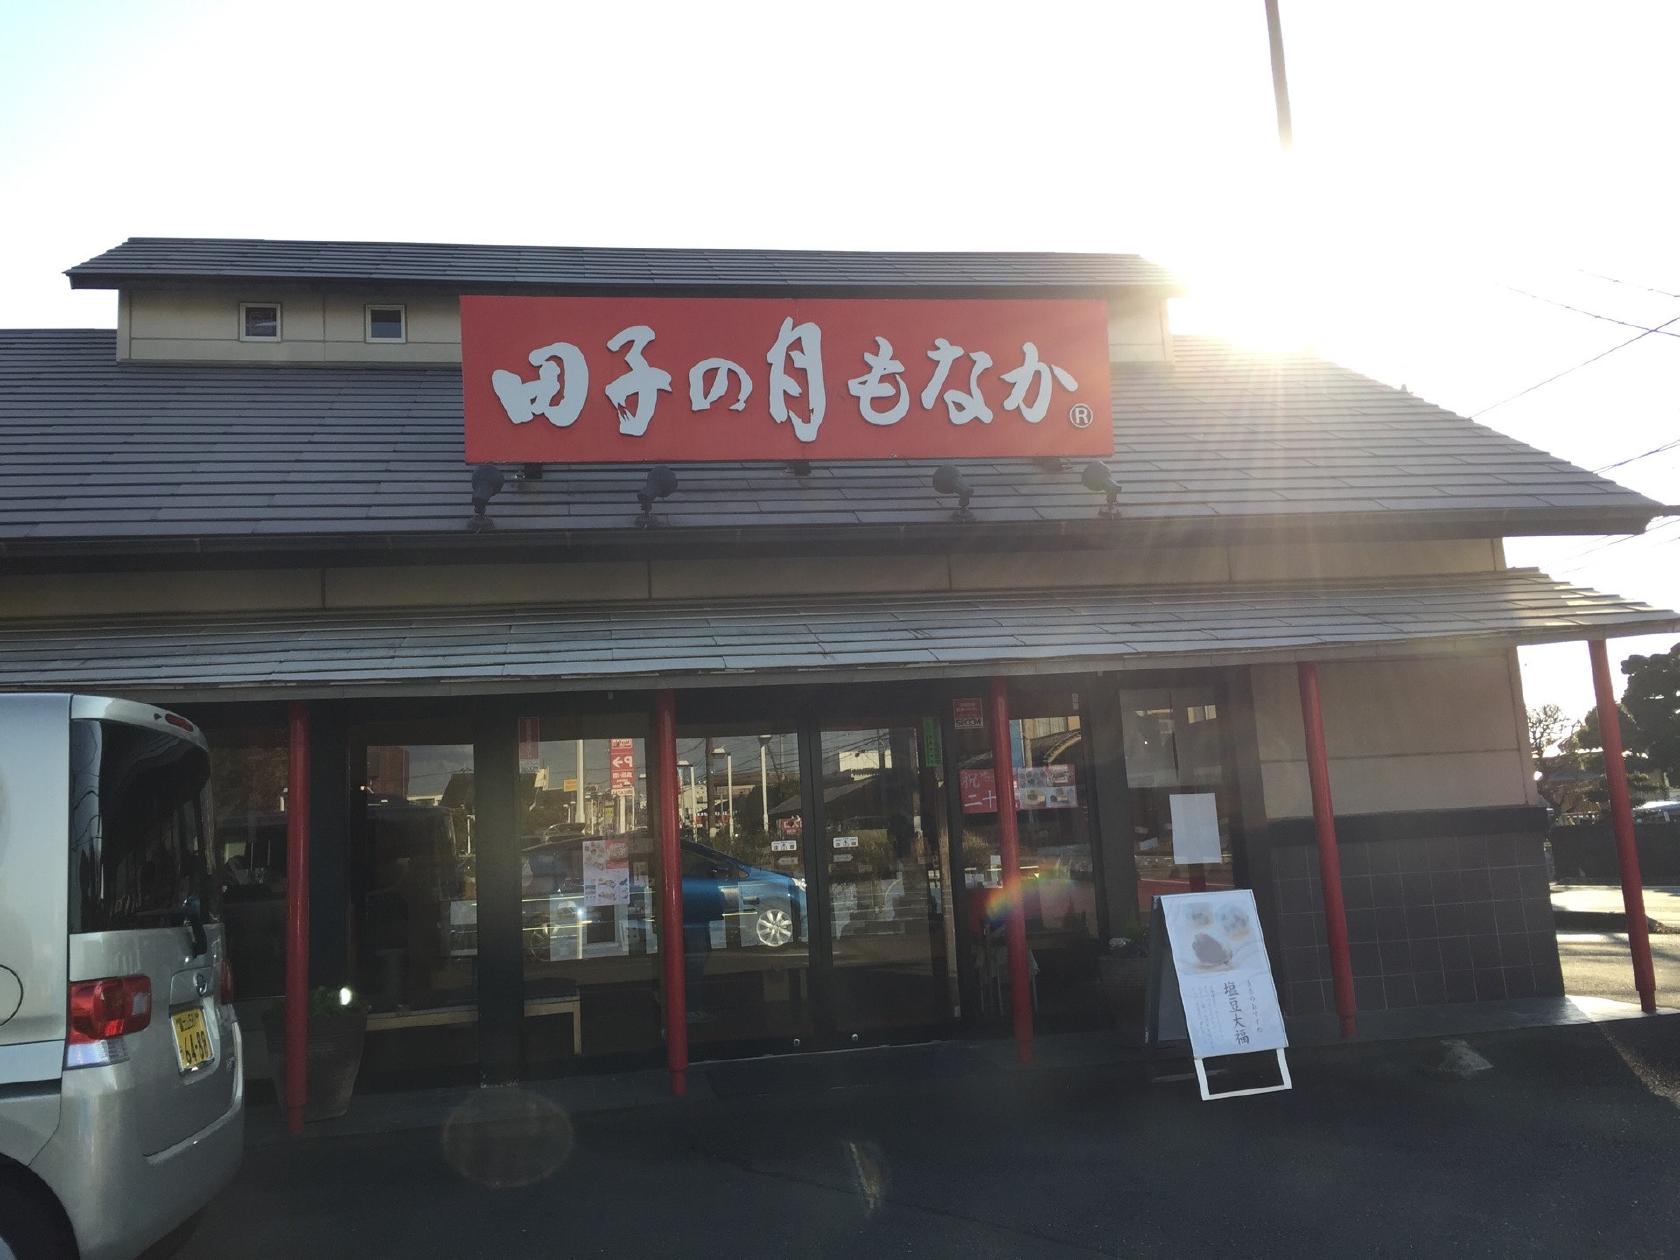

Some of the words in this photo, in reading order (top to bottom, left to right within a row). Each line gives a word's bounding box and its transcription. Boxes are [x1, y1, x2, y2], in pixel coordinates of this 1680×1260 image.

[491, 316, 1079, 442] 田子の月もなか
[1223, 980, 1250, 1046] 塩豆大福
